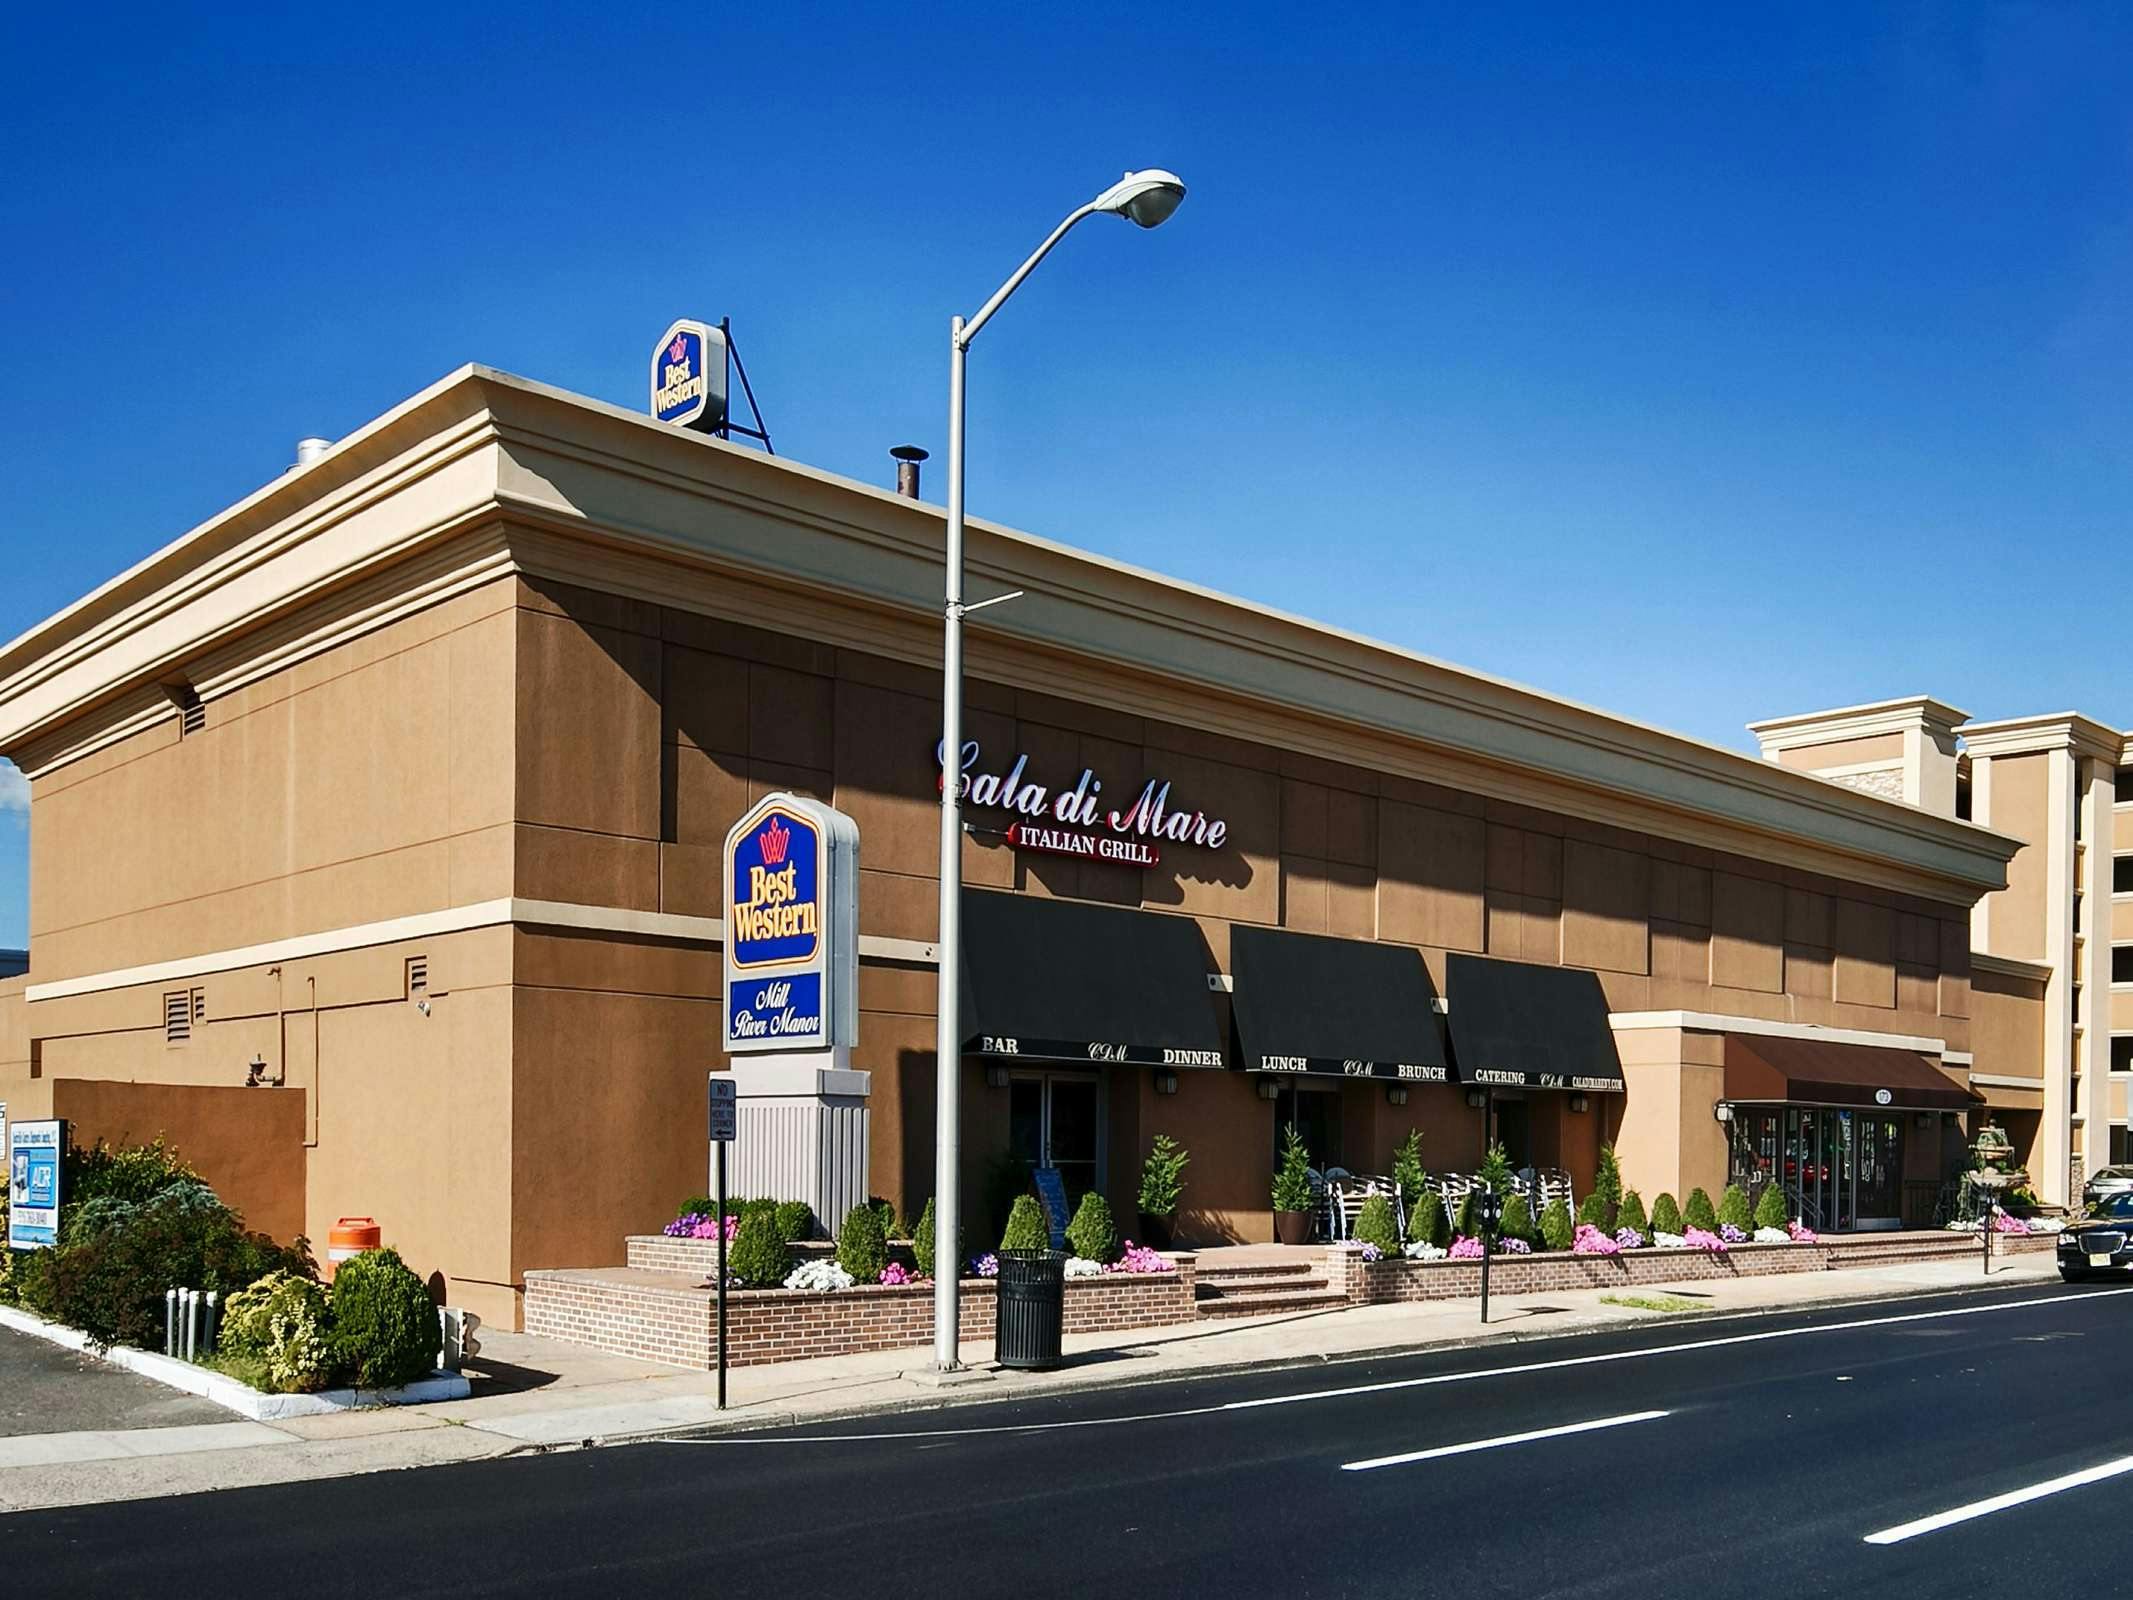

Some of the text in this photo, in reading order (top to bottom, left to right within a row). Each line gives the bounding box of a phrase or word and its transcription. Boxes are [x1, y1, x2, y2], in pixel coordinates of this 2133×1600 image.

[665, 356, 691, 388] Best
[656, 376, 701, 413] Western
[1055, 769, 1101, 826] di
[1106, 779, 1226, 848] Mare
[1020, 827, 1152, 863] ITALIAN GRILL
[750, 860, 797, 907] Best
[734, 902, 817, 942] Western
[755, 981, 791, 1009] Mill
[731, 1007, 820, 1038] River Manor
[982, 1036, 1019, 1053] BAR
[1163, 1049, 1222, 1066] DINNER
[1261, 1056, 1307, 1071] LUNCH
[1398, 1065, 1446, 1080] BRUNCH
[1475, 1069, 1525, 1085] CATERING
